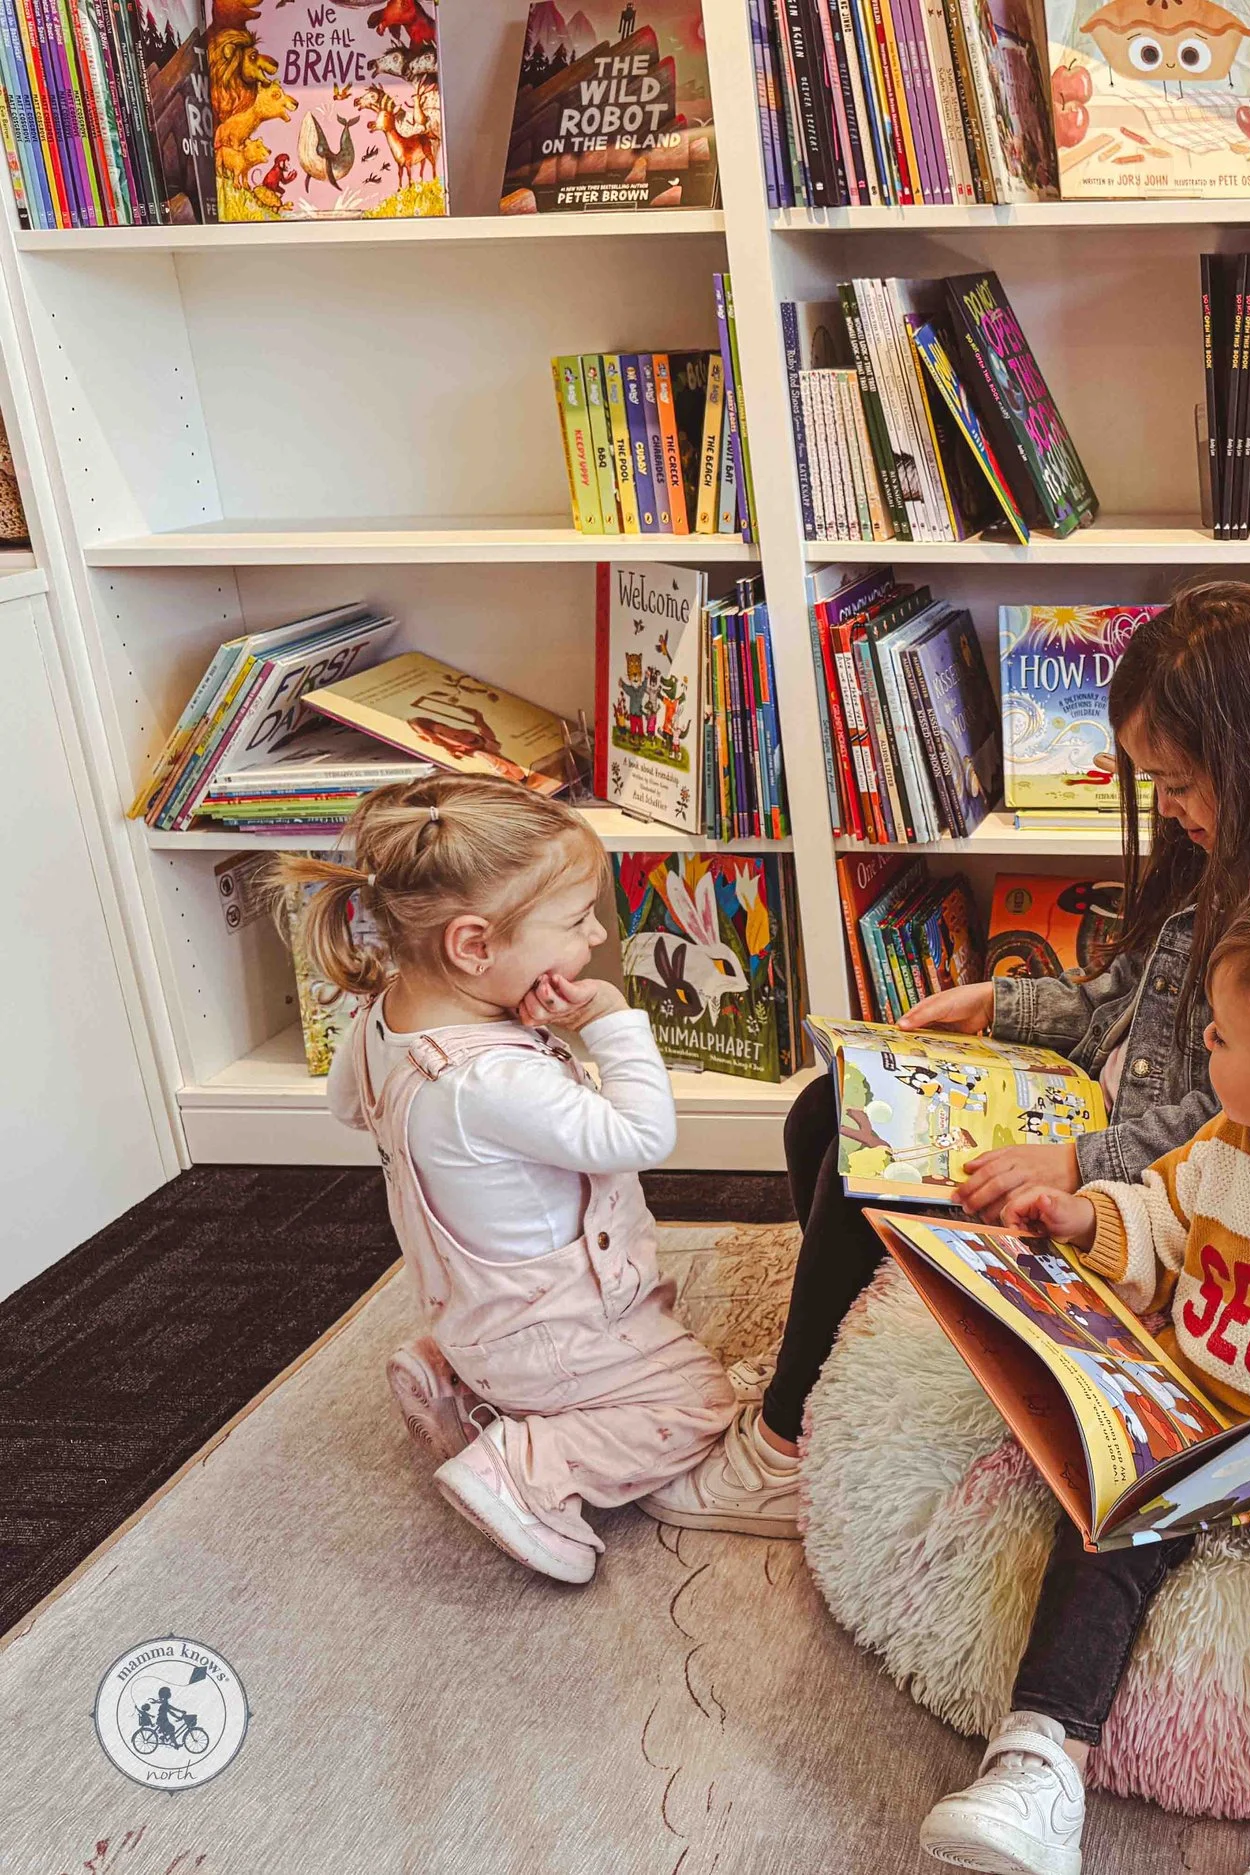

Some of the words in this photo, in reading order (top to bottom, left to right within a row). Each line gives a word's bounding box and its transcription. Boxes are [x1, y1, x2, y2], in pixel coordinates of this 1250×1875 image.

[308, 4, 336, 28] We
[330, 28, 355, 48] ALL
[284, 49, 366, 86] BRAVE
[595, 55, 650, 77] THE
[580, 77, 660, 105] WILD
[560, 104, 668, 136] ROBOT
[542, 140, 564, 154] ON
[571, 136, 608, 151] THE
[615, 133, 680, 149] ISLAND
[1108, 178, 1115, 186] BY
[1117, 175, 1141, 186] JORY
[1145, 175, 1168, 186] JOHN
[1219, 175, 1238, 186] PETE
[558, 192, 598, 204] PETER
[602, 190, 648, 202] BROWN
[981, 306, 1025, 358] OPEN
[787, 350, 797, 372] Ruby
[789, 372, 797, 388] Red
[975, 353, 985, 370] OPEN
[988, 385, 999, 402] BOOK
[1007, 353, 1048, 403] THIS
[791, 389, 800, 414] Shoes
[575, 429, 586, 461] KEEPY
[581, 462, 589, 486] UPPY
[635, 441, 647, 475] CUBBY
[652, 435, 664, 484] CHARADES
[666, 435, 674, 452] THE
[707, 435, 715, 452] THE
[620, 458, 628, 482] POOL
[668, 453, 679, 486] CREEK
[704, 452, 714, 486] BEACH
[725, 466, 733, 484] BAT
[617, 570, 690, 623] Welcome
[267, 641, 370, 710] FIRST
[1020, 654, 1085, 692] HOW
[1093, 653, 1124, 688] D
[917, 709, 930, 739] KISSED
[929, 752, 941, 778] MOON
[927, 708, 940, 737] KISSED
[939, 751, 951, 776] MOON
